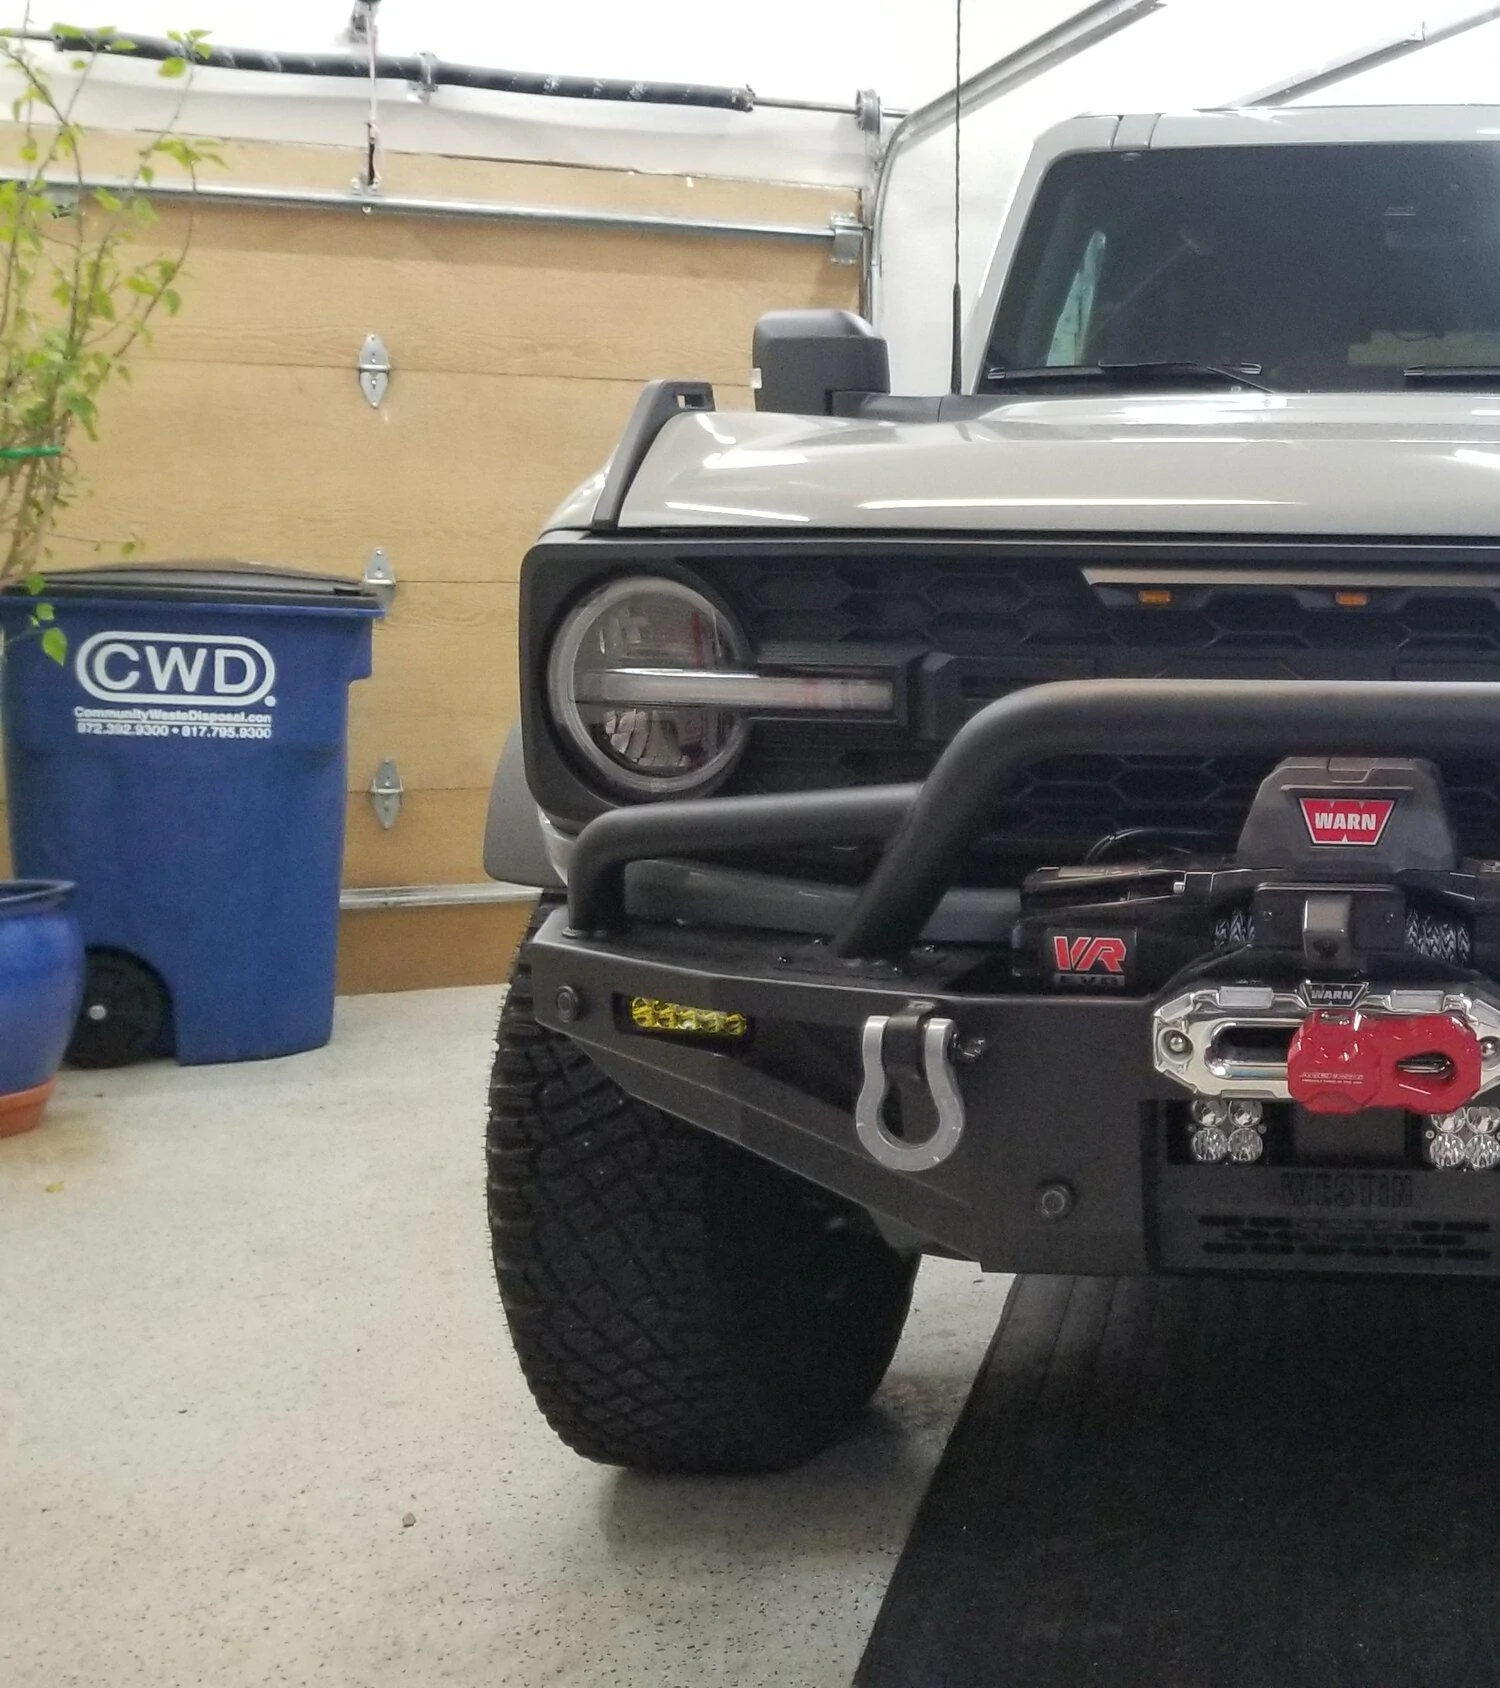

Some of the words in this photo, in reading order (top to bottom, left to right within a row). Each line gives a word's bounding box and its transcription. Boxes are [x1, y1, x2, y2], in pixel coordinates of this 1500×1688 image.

[94, 643, 256, 693] CWD
[1315, 812, 1377, 831] WARN
[1053, 936, 1127, 972] VR
[1312, 990, 1353, 1000] WARN
